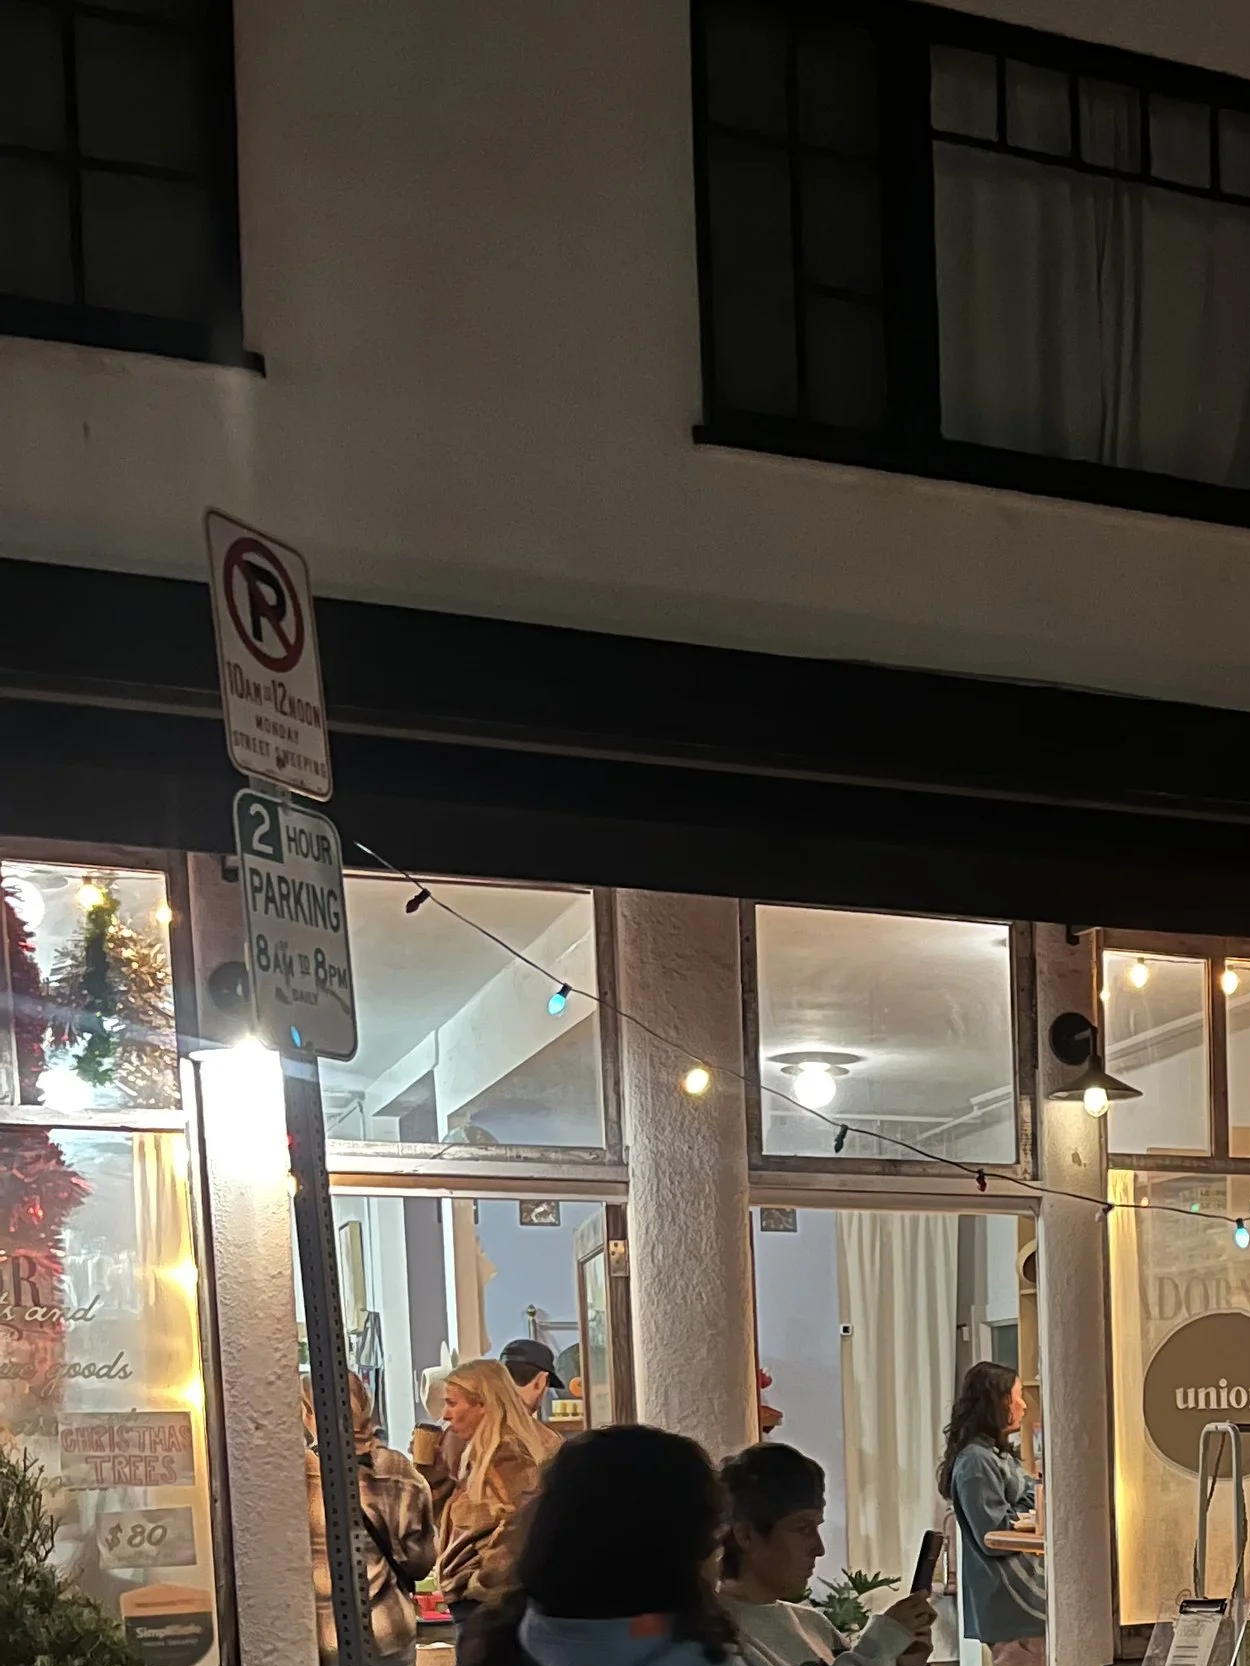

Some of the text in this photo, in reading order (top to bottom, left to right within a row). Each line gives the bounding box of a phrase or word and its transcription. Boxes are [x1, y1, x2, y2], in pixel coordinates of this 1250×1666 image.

[226, 660, 263, 706] 10AM
[232, 730, 270, 757] STREET
[255, 714, 299, 744] MONDAY
[249, 803, 333, 866] 2 HOUR
[249, 867, 341, 933] PARKING
[256, 933, 295, 977] 8AM
[314, 947, 348, 990] 8PM
[25, 1294, 101, 1322] and
[42, 1351, 133, 1397] goods
[61, 1424, 193, 1454] CHRISTMAS
[85, 1454, 177, 1486] TREES
